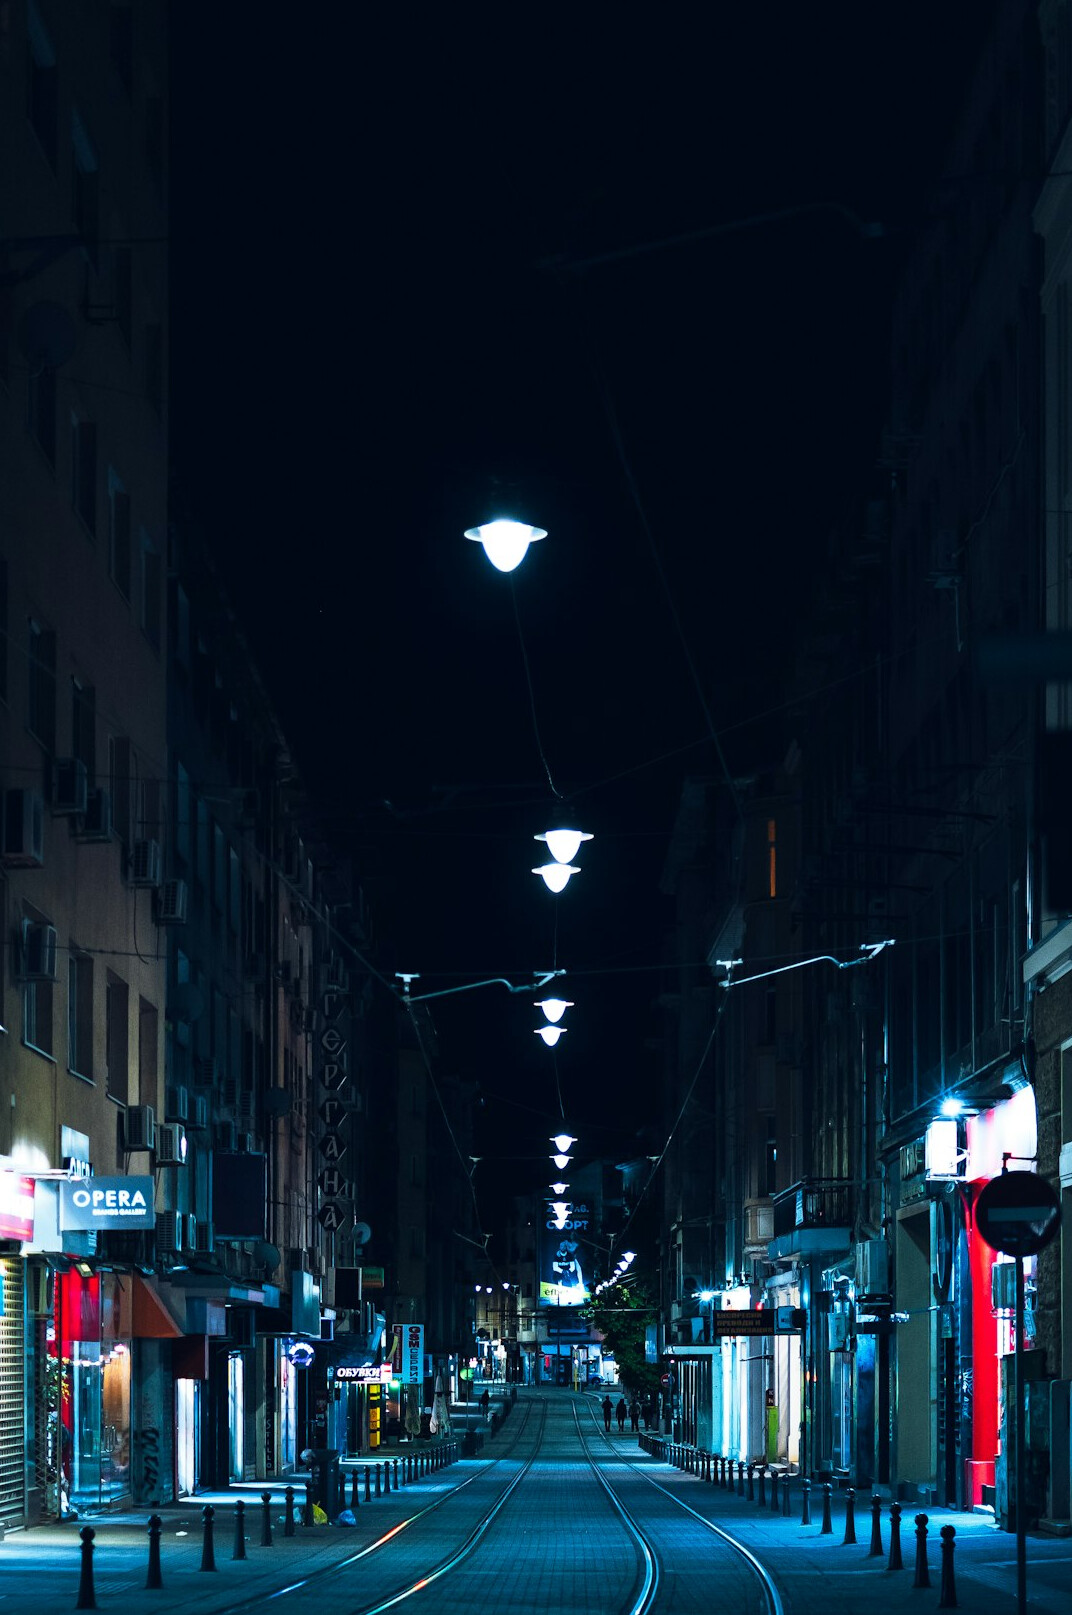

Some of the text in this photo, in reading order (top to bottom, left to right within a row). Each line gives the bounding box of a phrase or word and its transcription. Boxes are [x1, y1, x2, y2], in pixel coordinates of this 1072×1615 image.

[72, 1190, 147, 1208] OPERA
[119, 1208, 147, 1216] GALLERY
[336, 1367, 381, 1378] ОБУВКИ
